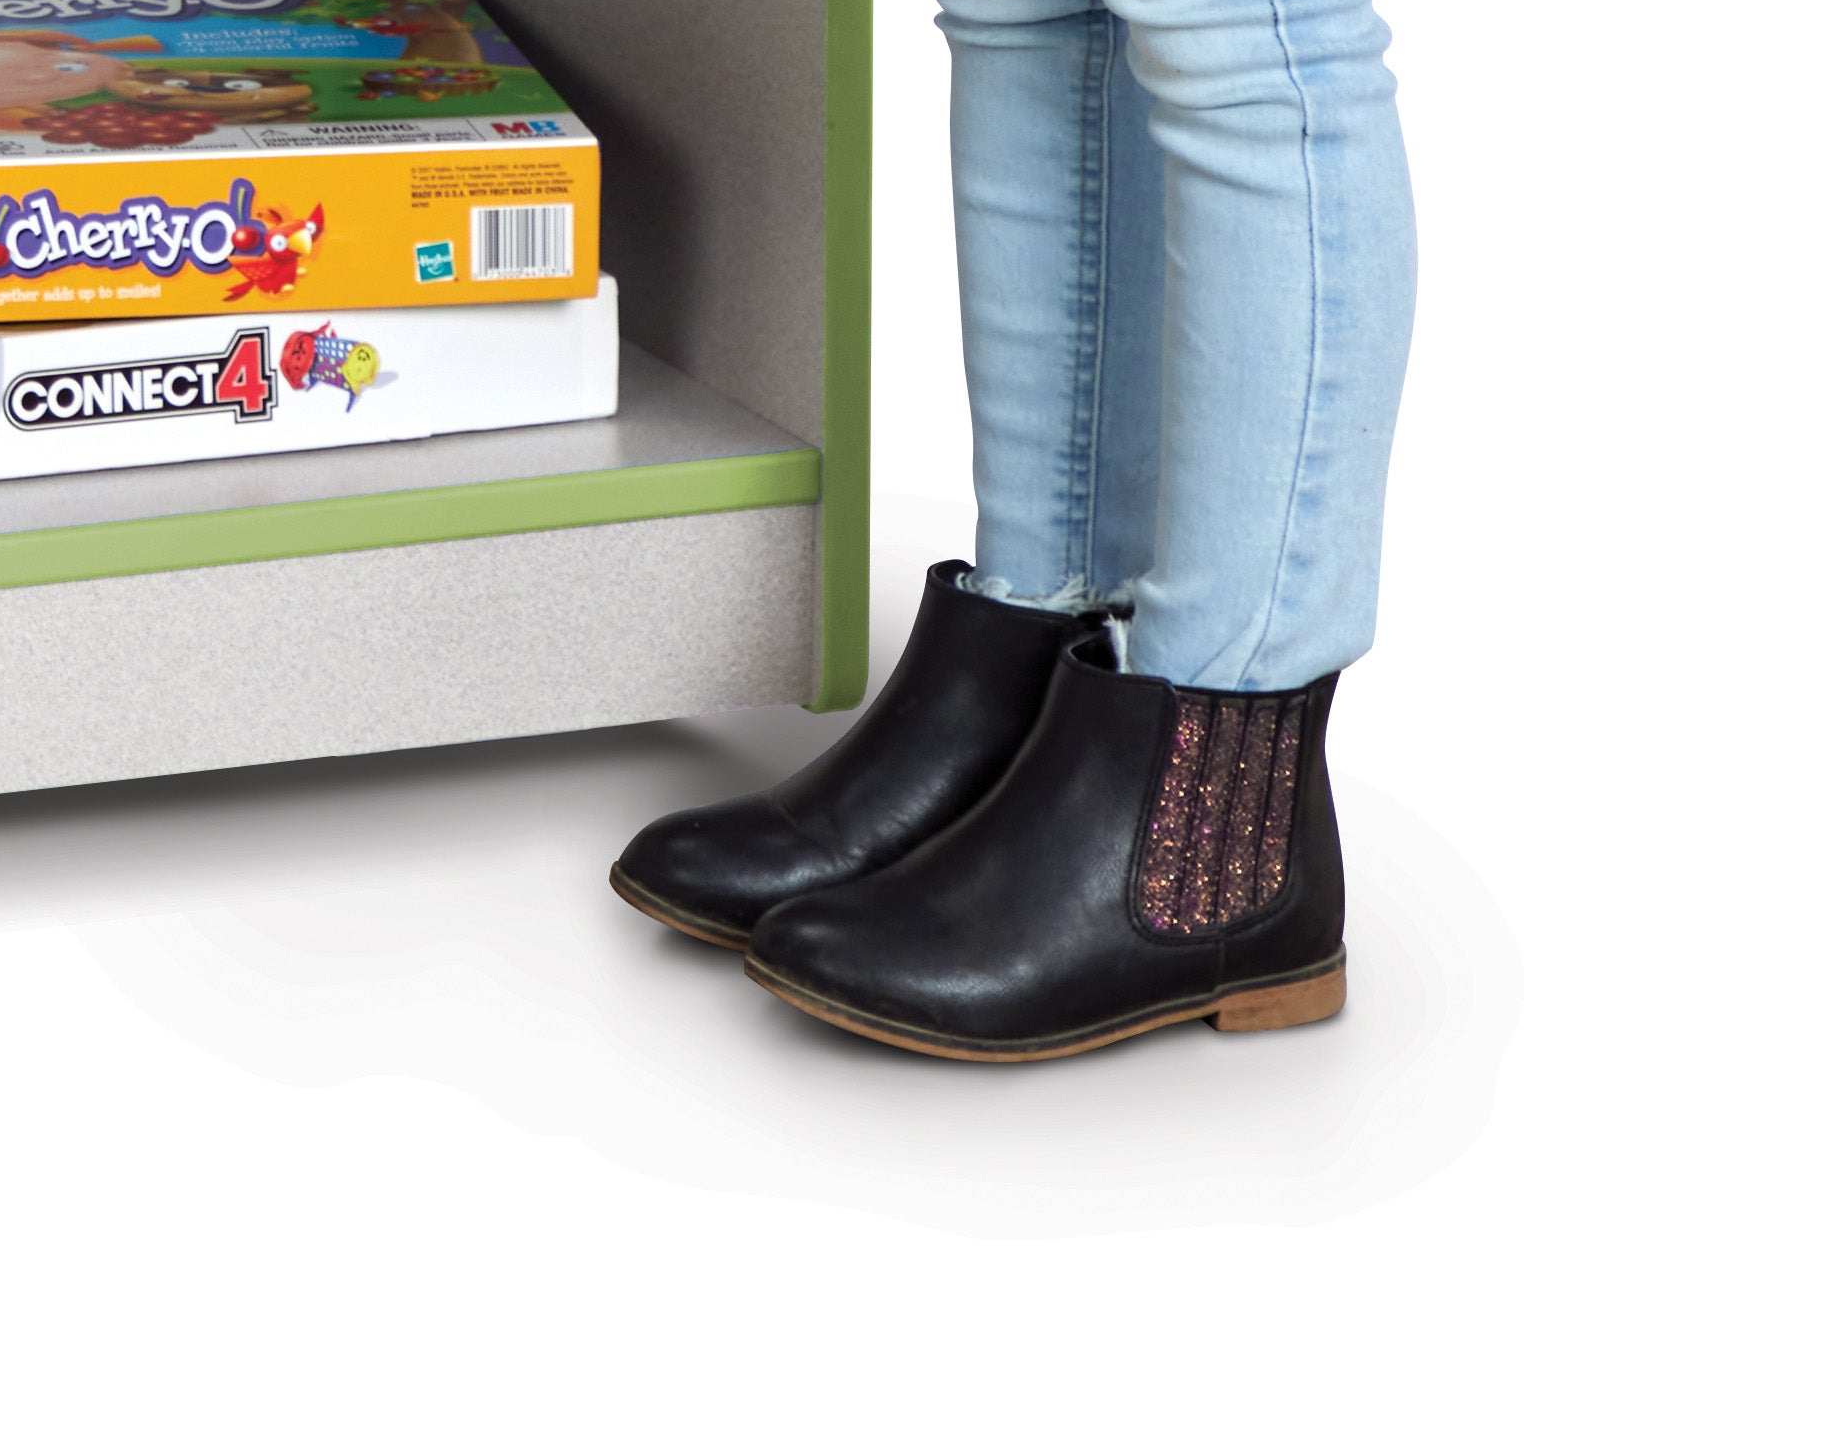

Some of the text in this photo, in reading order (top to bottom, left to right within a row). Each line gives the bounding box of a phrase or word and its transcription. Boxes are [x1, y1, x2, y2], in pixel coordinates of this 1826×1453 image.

[44, 286, 75, 302] adds
[79, 290, 96, 303] up
[98, 286, 113, 299] to
[117, 284, 162, 299] smiles!
[12, 337, 268, 422] CONNECT 4
